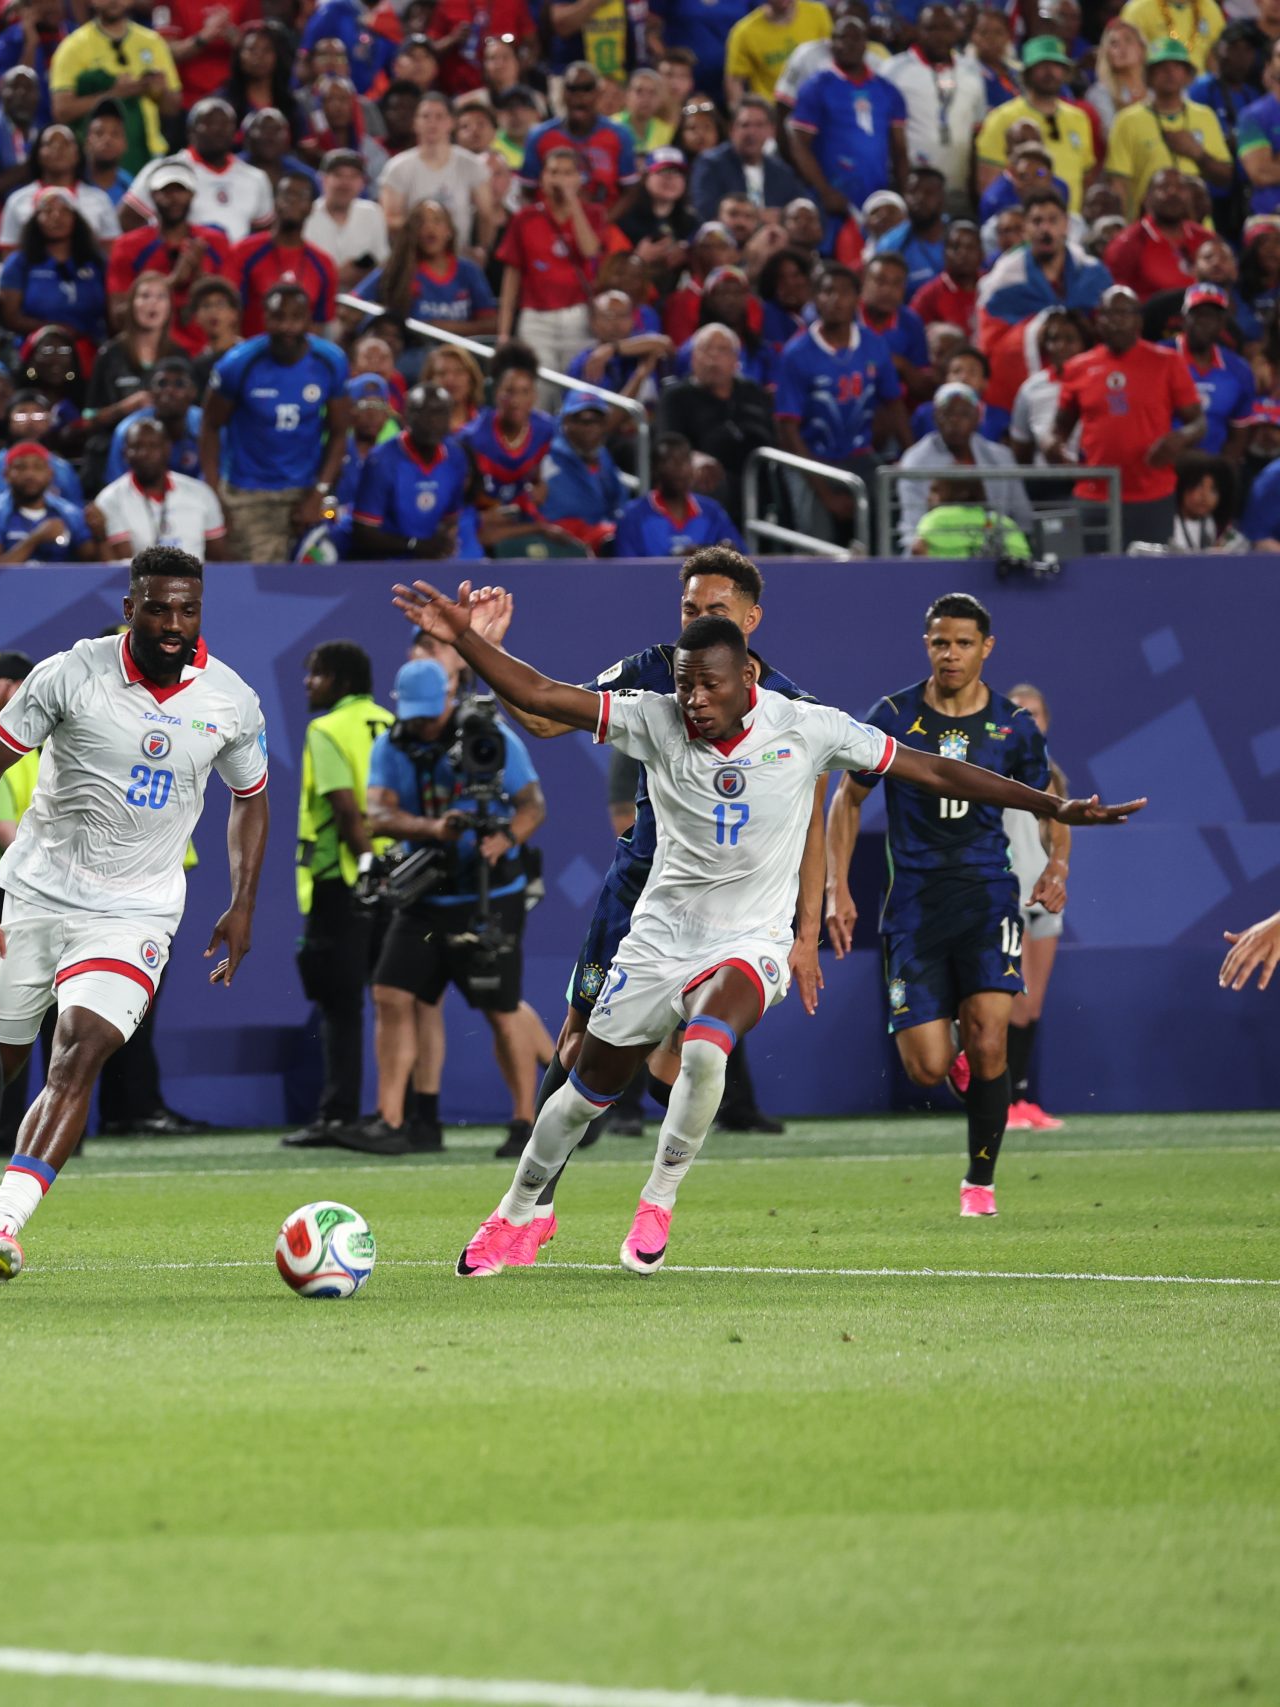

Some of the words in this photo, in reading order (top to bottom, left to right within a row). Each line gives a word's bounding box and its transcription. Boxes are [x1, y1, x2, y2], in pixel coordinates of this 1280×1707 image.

[139, 711, 183, 727] SAETA
[125, 764, 173, 810] 20
[712, 803, 750, 846] 17
[665, 1145, 689, 1158] FHF
